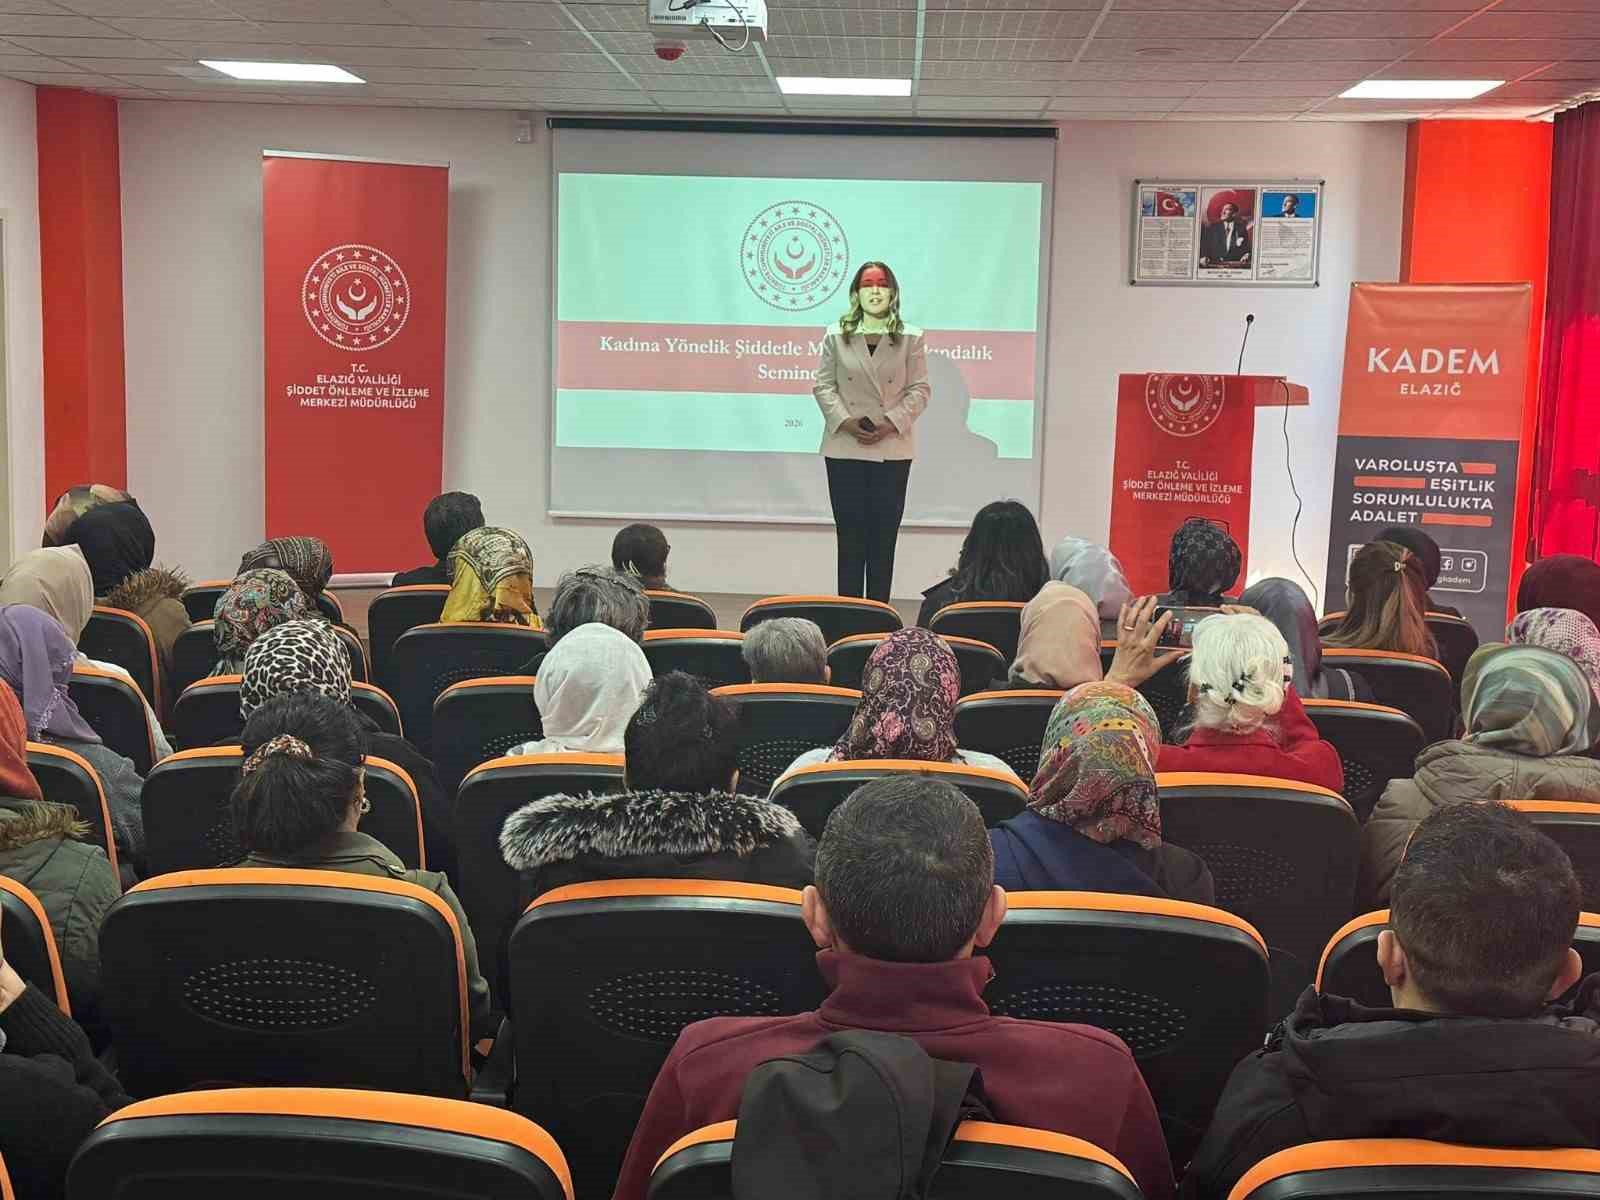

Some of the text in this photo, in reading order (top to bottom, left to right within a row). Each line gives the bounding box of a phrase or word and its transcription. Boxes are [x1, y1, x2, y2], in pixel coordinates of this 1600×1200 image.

[600, 336, 660, 353] Kadına
[664, 337, 730, 355] Yönelik
[735, 339, 803, 359] Şiddetle
[350, 362, 369, 373] T.C.
[1367, 347, 1499, 375] KADEM
[757, 363, 817, 381] Semine
[316, 374, 401, 386] ELAZIĞ VALİLİĞİ
[286, 383, 430, 399] ŞİDDET ÖNLEME VE İZLEME
[1399, 382, 1462, 397] ELAZIĞ
[299, 397, 417, 410] MERKEZİ MÜDÜRLÜĞÜ
[1354, 458, 1458, 474] VAROLUŞTA
[1147, 470, 1180, 481] ELAZIĞ
[1123, 478, 1155, 491] ŞİDDET
[1156, 480, 1195, 492] ÖNLEME
[1196, 483, 1209, 493] VE
[1430, 478, 1496, 493] EŞİTLİK
[1132, 491, 1173, 502] MERKEZİ
[1352, 492, 1494, 511] SORUMLULUKTA
[1350, 509, 1419, 523] ADALET
